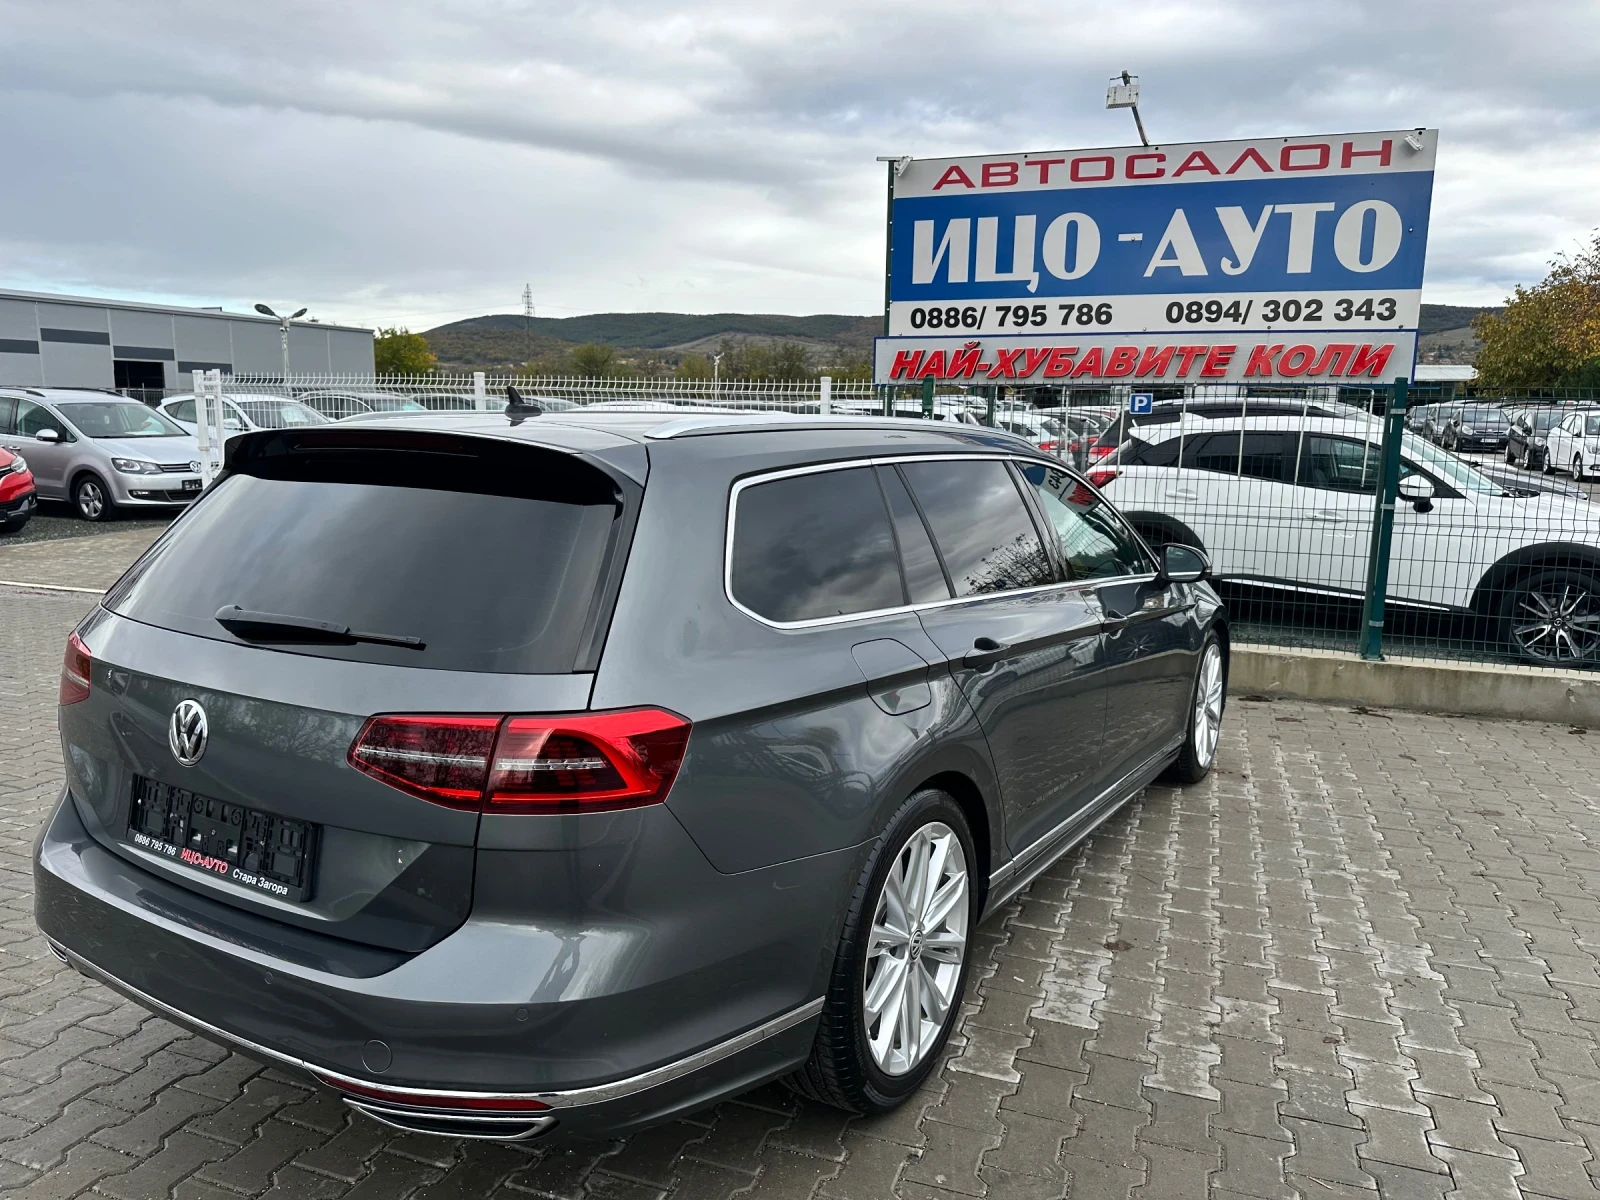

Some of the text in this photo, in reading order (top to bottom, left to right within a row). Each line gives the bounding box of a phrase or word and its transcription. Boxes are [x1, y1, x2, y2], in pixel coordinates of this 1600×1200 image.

[932, 140, 1393, 190] АВТОСАЛОН
[910, 297, 1397, 330] 0886/ 795 786 0894/ 302 343
[889, 340, 1396, 380] НАЙ-ХУБАВИТЕ КОЛИ
[1134, 396, 1148, 411] P
[134, 833, 288, 896] 0886 795 786 ИЦО-АУТО Стара Загора
